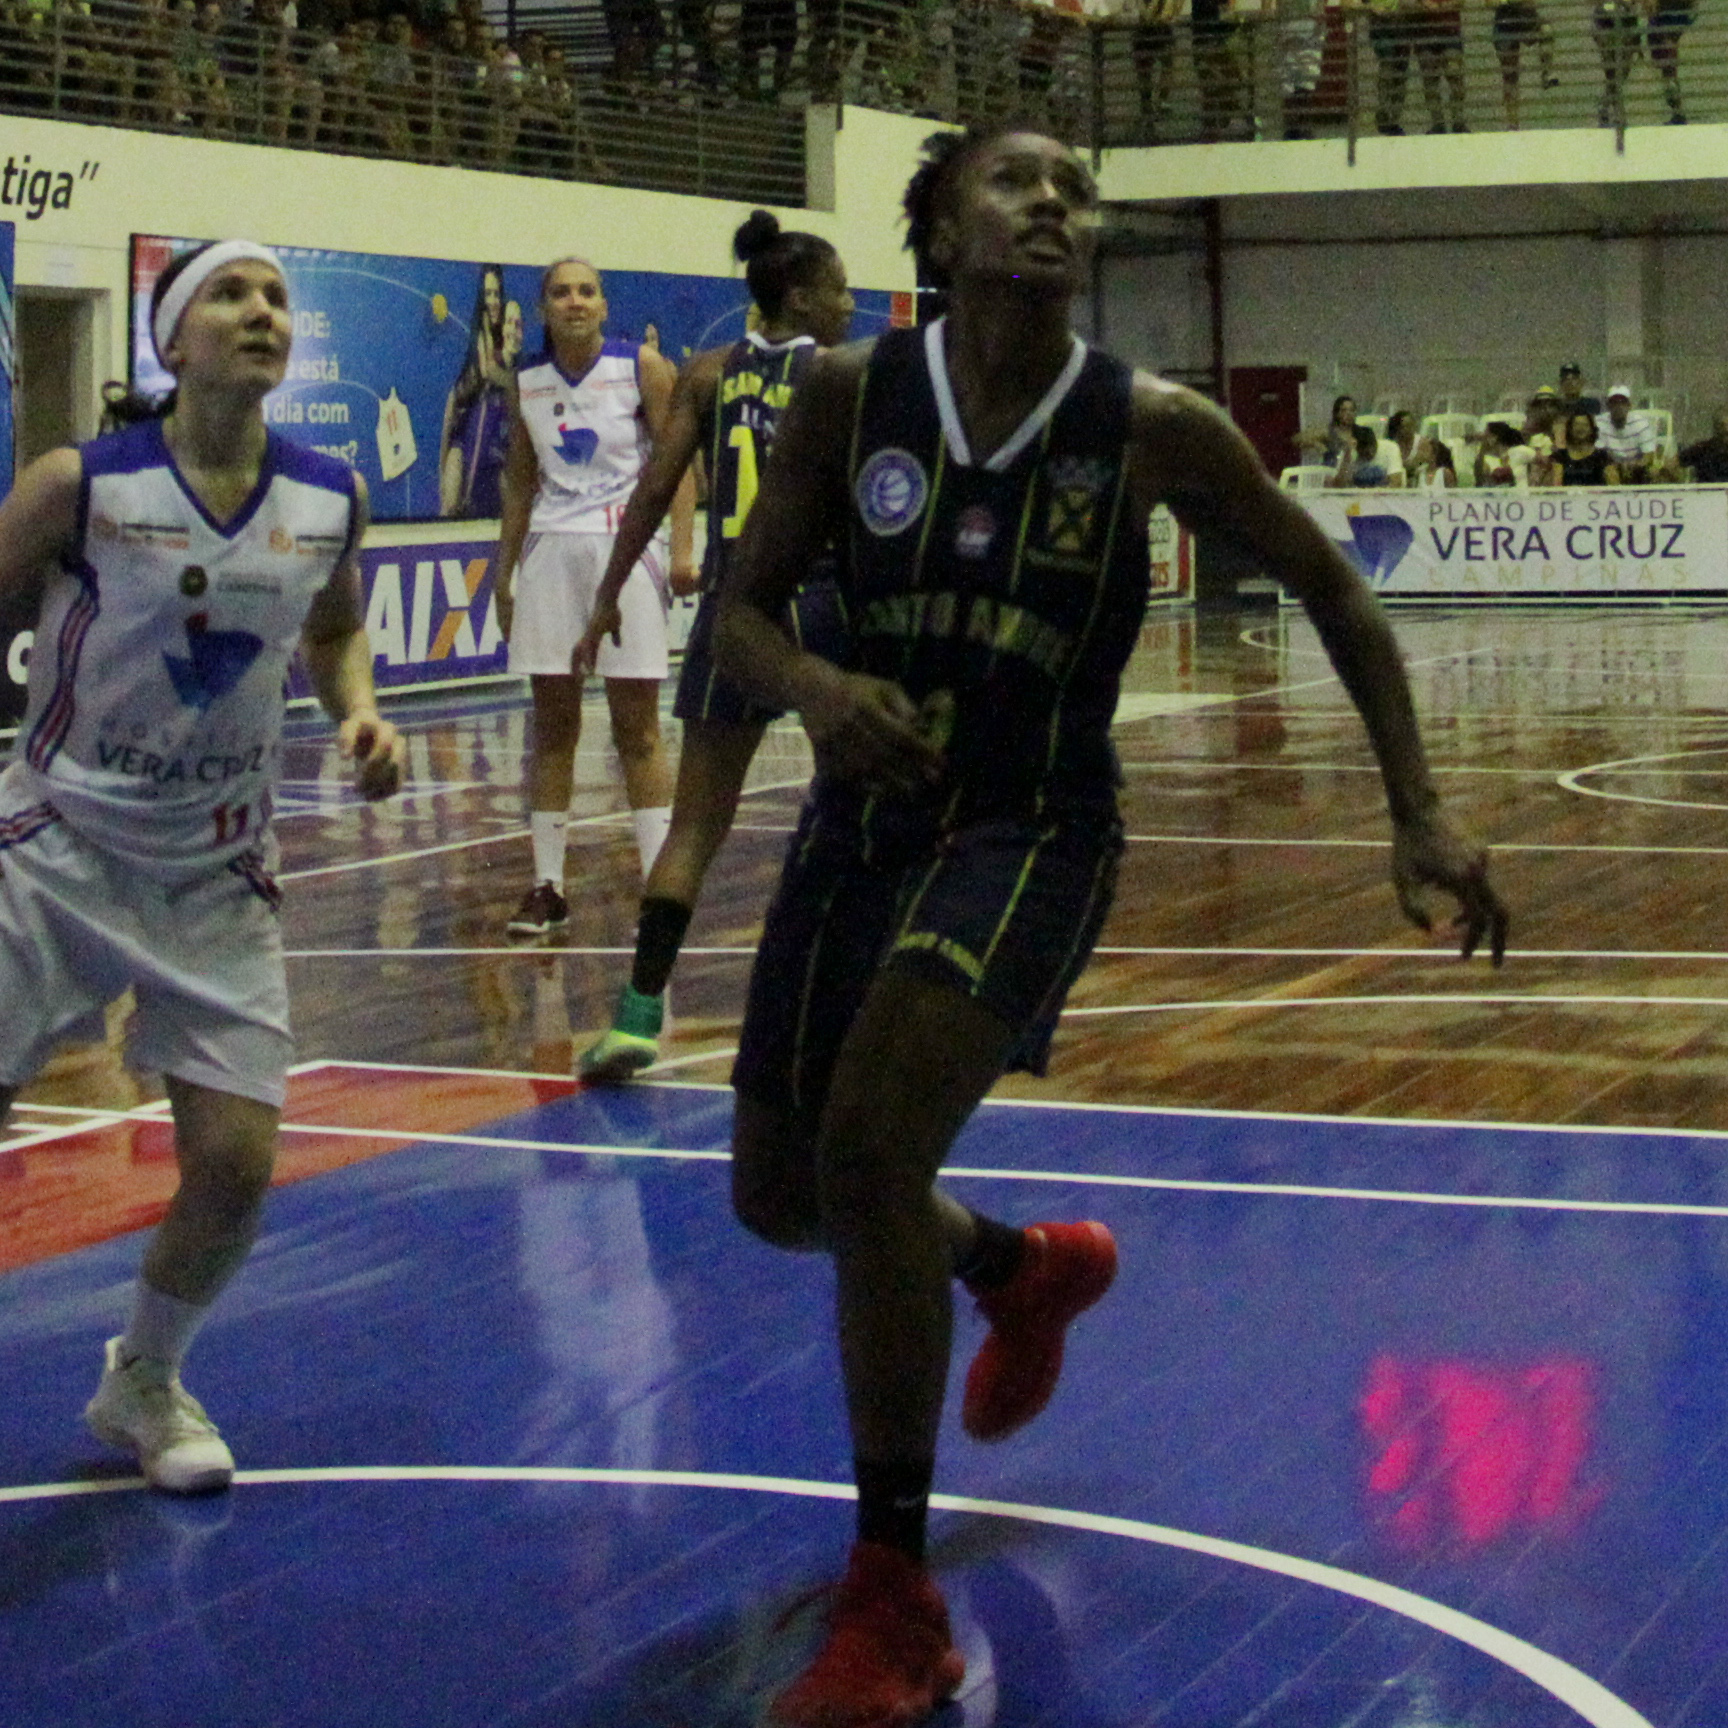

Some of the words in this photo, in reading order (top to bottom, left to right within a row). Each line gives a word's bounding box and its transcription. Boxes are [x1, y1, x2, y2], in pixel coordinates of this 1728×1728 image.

[273, 396, 303, 424] dia
[308, 401, 350, 424] com
[1429, 501, 1525, 522] PLANO
[1538, 500, 1572, 521] DE
[1587, 493, 1684, 521] SAÚDE
[1429, 525, 1551, 561] VERA
[1565, 523, 1686, 560] CRUZ
[1429, 564, 1690, 586] CAMPINAS
[364, 557, 512, 667] AIXA
[97, 739, 185, 783] VERA
